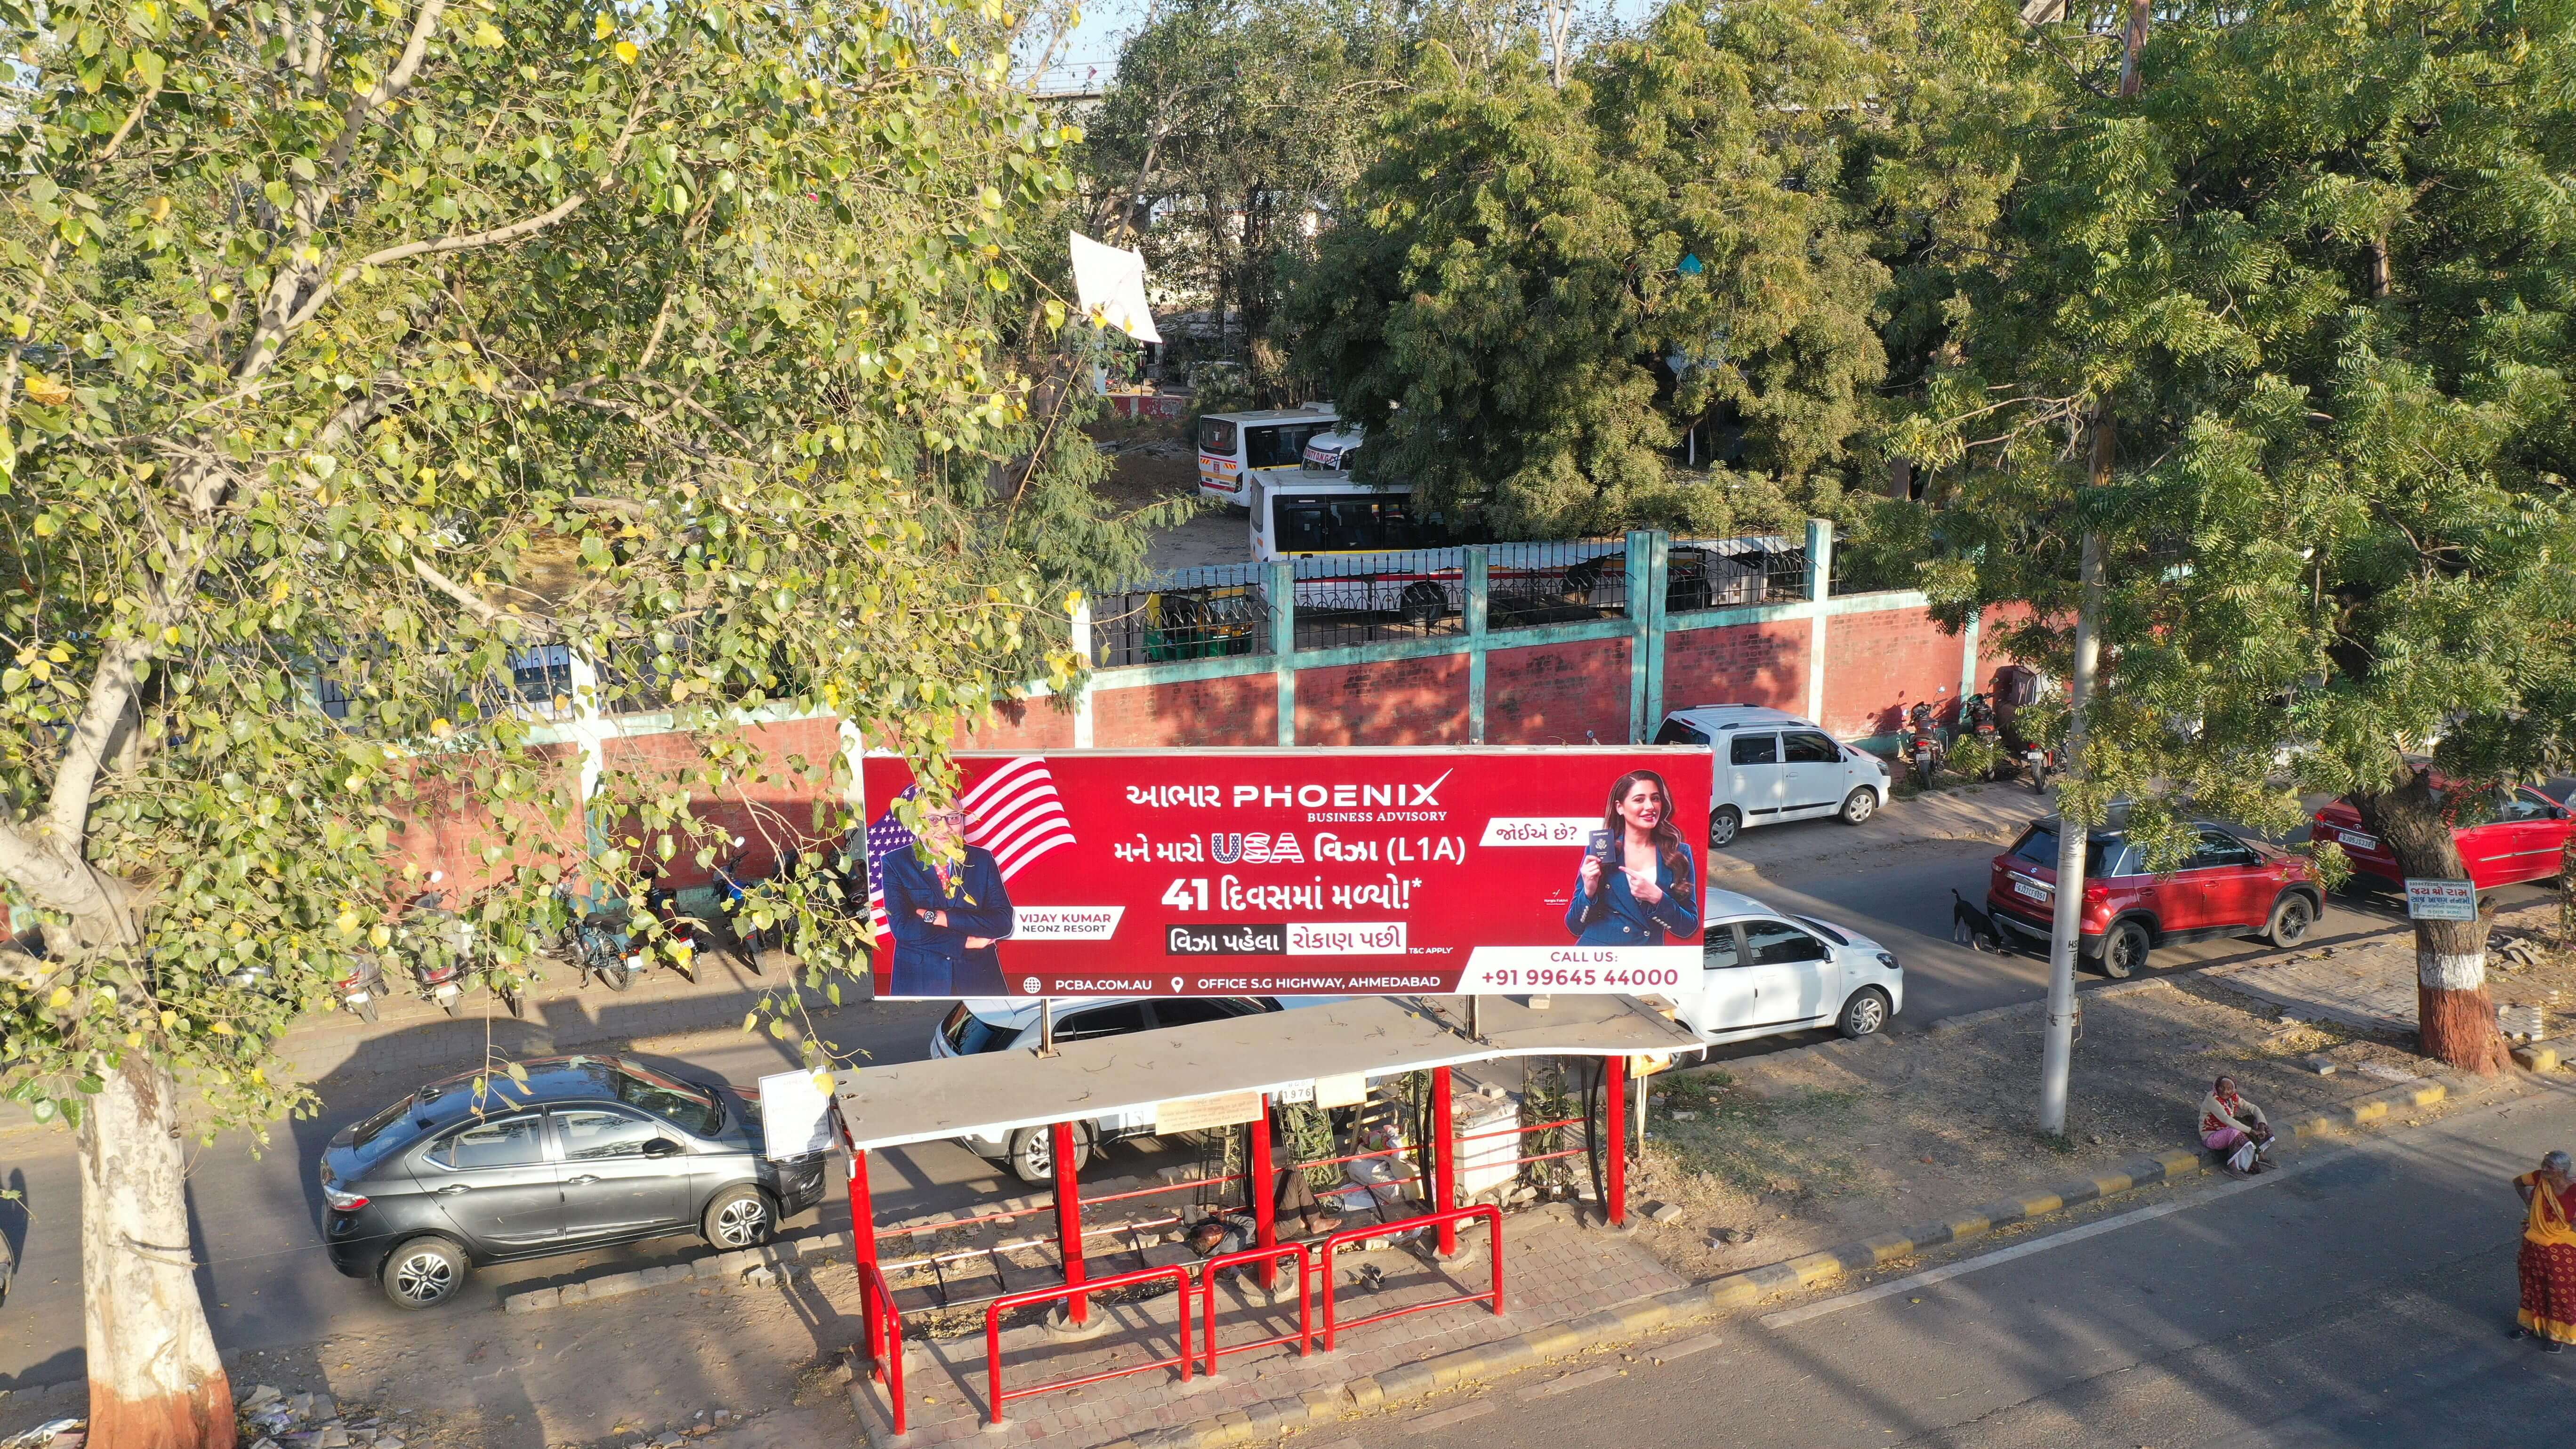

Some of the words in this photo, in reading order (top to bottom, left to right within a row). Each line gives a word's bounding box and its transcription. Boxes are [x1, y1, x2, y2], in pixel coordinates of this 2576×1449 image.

[1127, 786, 1221, 807] આભાર
[1234, 768, 1453, 807] PHOENIX
[1308, 813, 1372, 822] BUSINESS
[1377, 812, 1447, 821] ADVISORY
[1497, 824, 1547, 840] જોઈએ
[1554, 823, 1577, 840] છે?
[1115, 834, 1151, 862] મને
[1157, 834, 1204, 862] મારો
[1212, 832, 1304, 864] USA
[1315, 833, 1378, 861] વિઝા
[1387, 837, 1465, 866] (L1A)
[1162, 879, 1208, 910] 41
[1221, 875, 1323, 910] દિવસમાં
[2432, 886, 2444, 895] શ્રી
[2446, 888, 2467, 896] રામ
[1062, 914, 1111, 922] KUMAR
[1171, 928, 1217, 951] વિઝા
[1223, 927, 1280, 951] પહેલા
[1293, 926, 1352, 950] રોકાણ
[1360, 926, 1400, 947] પછી
[1551, 952, 1588, 961] CALL
[1594, 952, 1618, 961] US:
[1198, 979, 1247, 989] OFFICE
[1251, 979, 1272, 988] S.G
[1277, 978, 1345, 989] HIGHWAY,
[1348, 977, 1440, 987] AHMEDABAD
[1483, 970, 1516, 985] +91
[1527, 970, 1595, 985] 99645
[1604, 970, 1677, 985] 44000
[1056, 980, 1151, 990] PCBA.COM.AU
[1284, 1088, 1311, 1099] 1976
